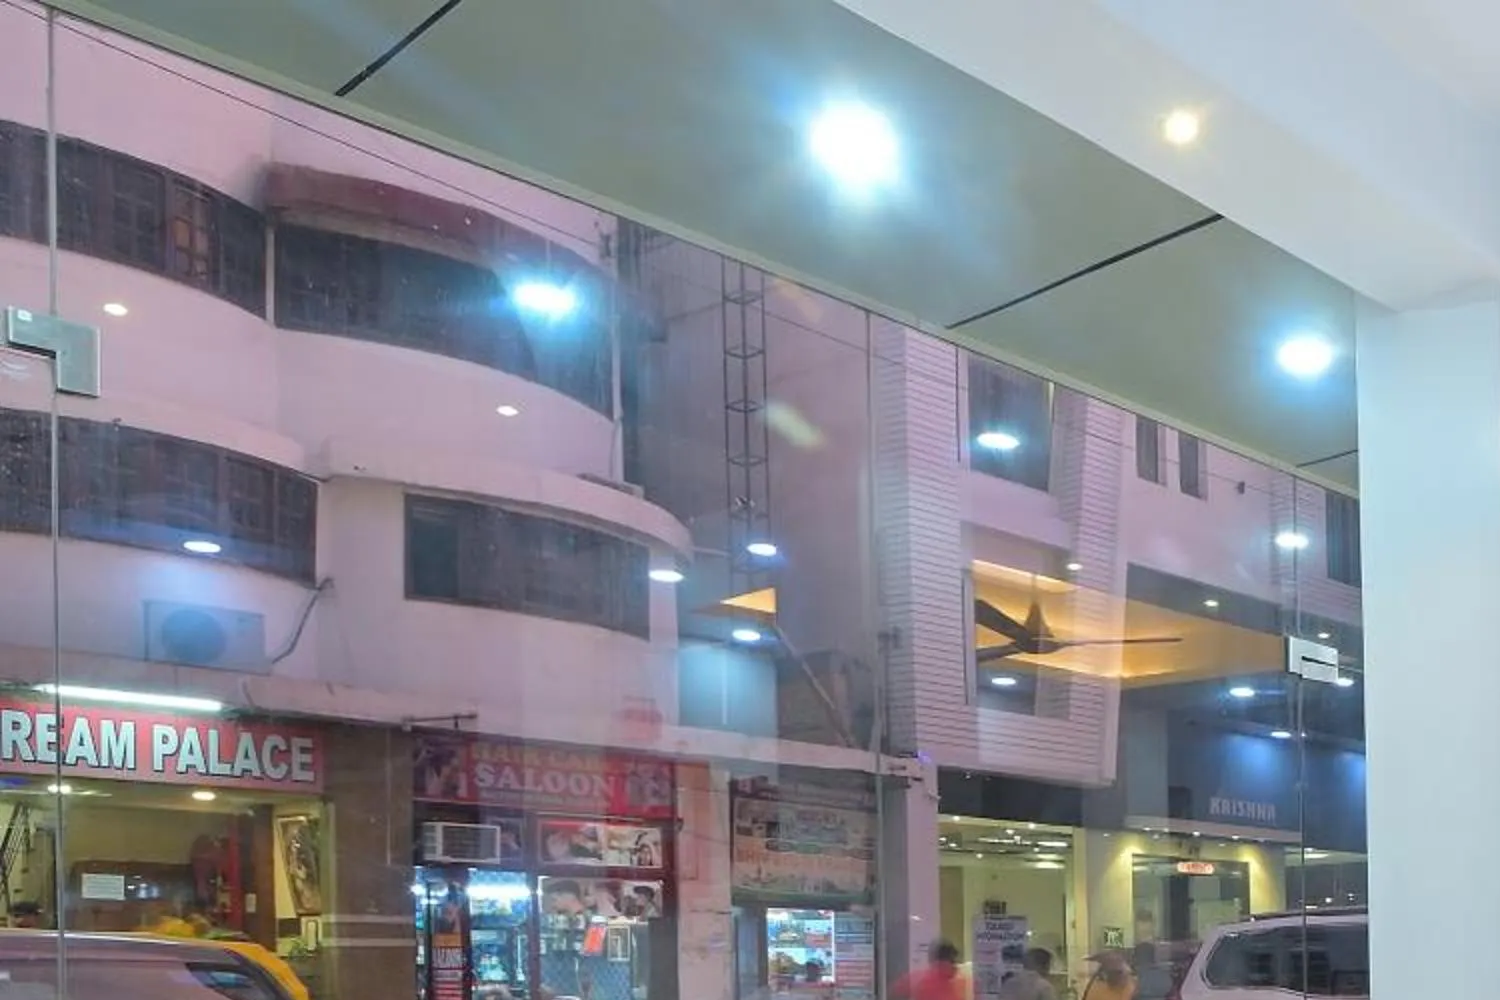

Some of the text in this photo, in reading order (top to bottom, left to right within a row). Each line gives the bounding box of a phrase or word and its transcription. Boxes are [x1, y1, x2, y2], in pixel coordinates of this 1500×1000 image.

[1, 708, 316, 783] REAM PALACE
[474, 763, 615, 797] SALOON
